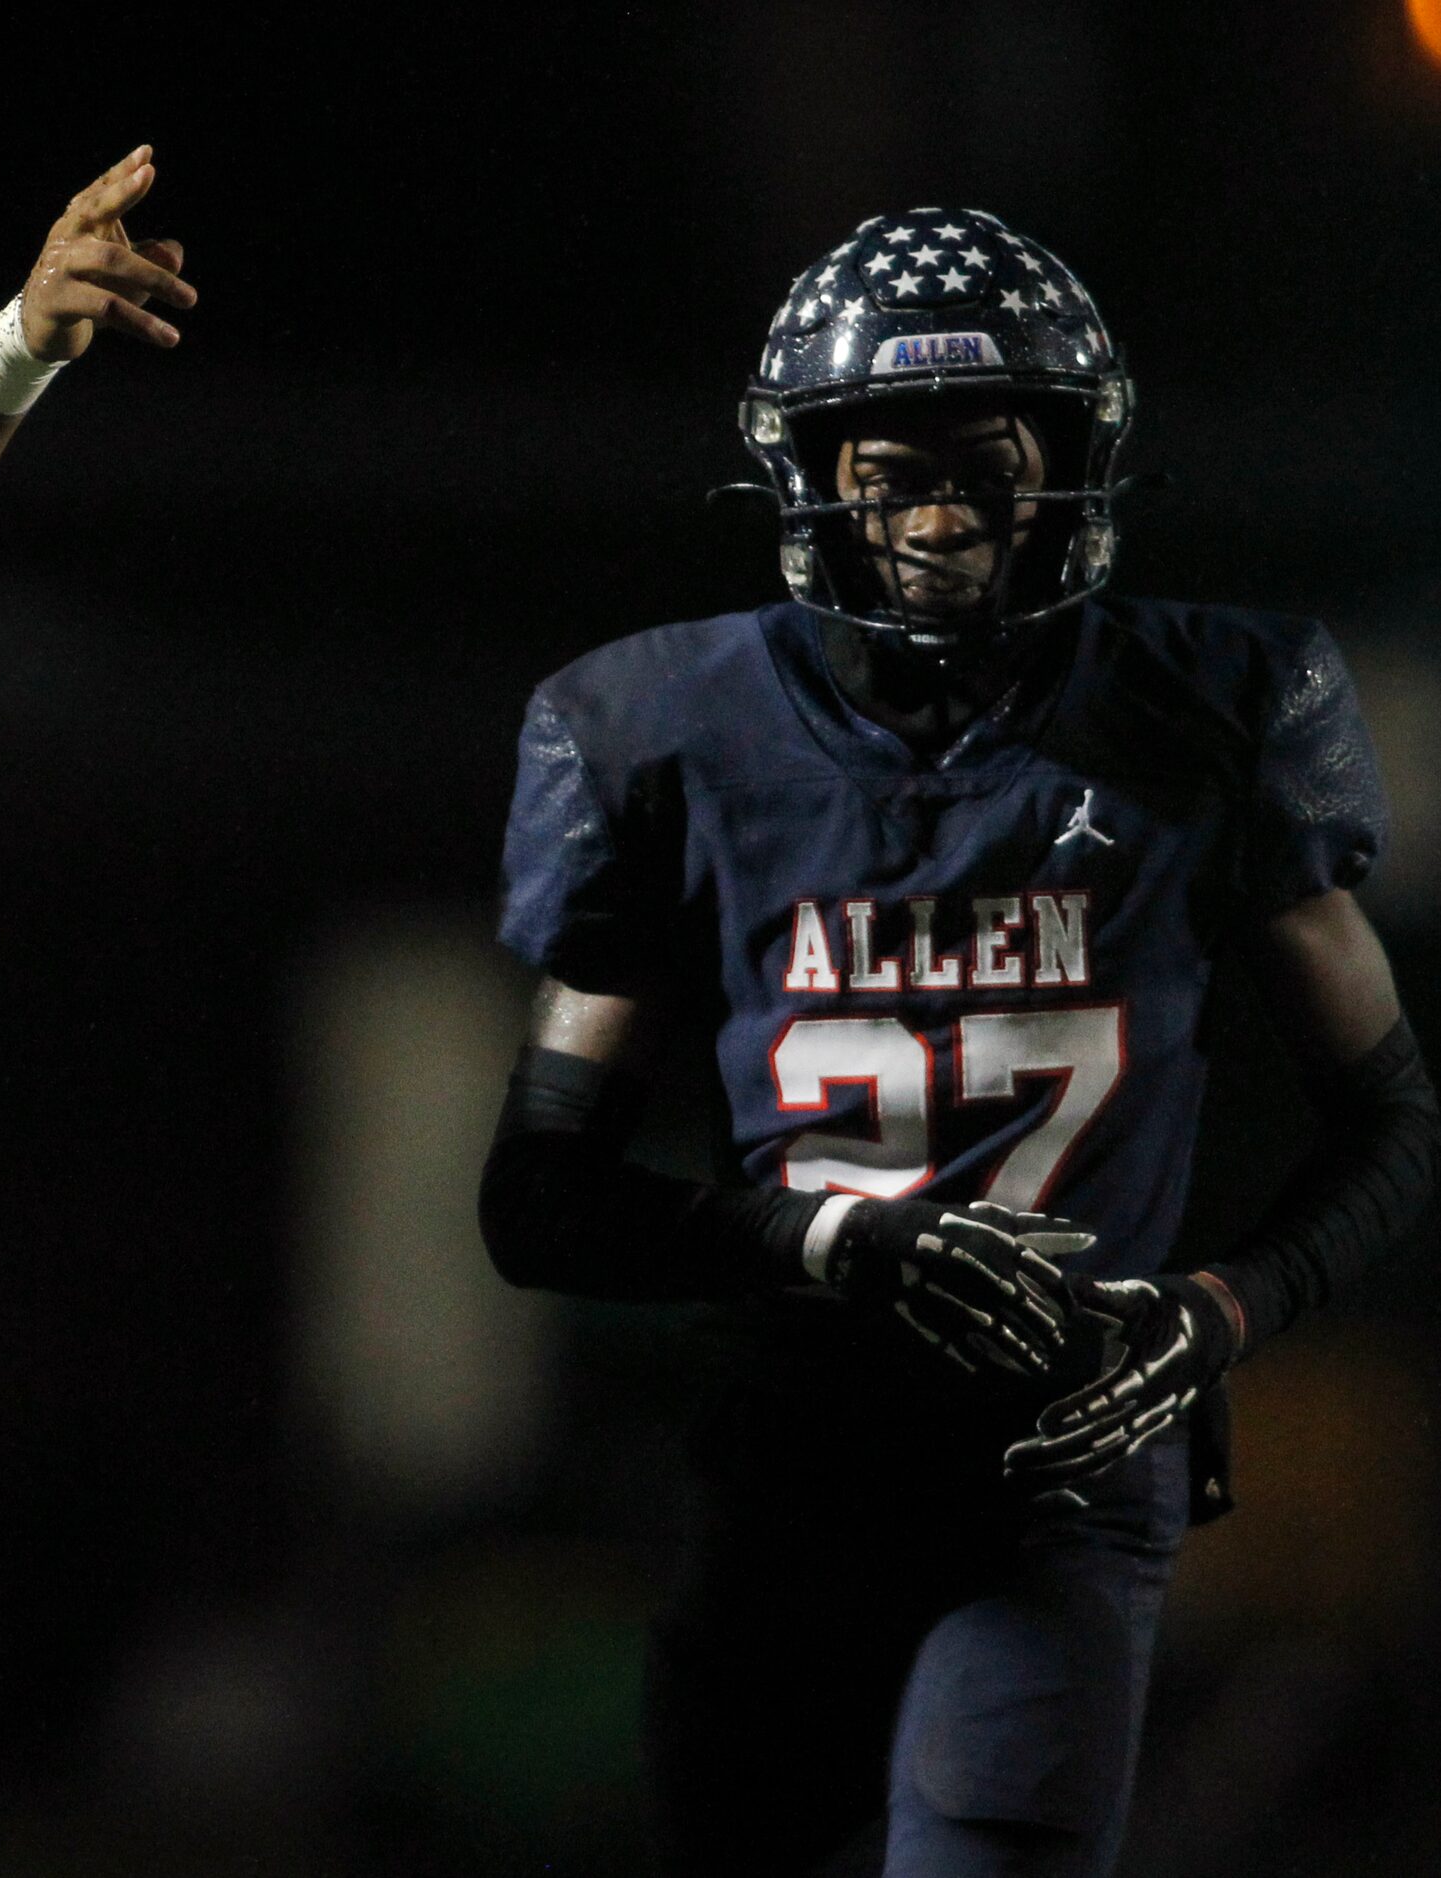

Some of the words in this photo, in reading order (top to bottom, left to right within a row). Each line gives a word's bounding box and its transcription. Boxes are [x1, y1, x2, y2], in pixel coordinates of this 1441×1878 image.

[892, 336, 983, 368] ALLEN
[783, 891, 1091, 992] ALLEN
[768, 1001, 1127, 1211] 27
